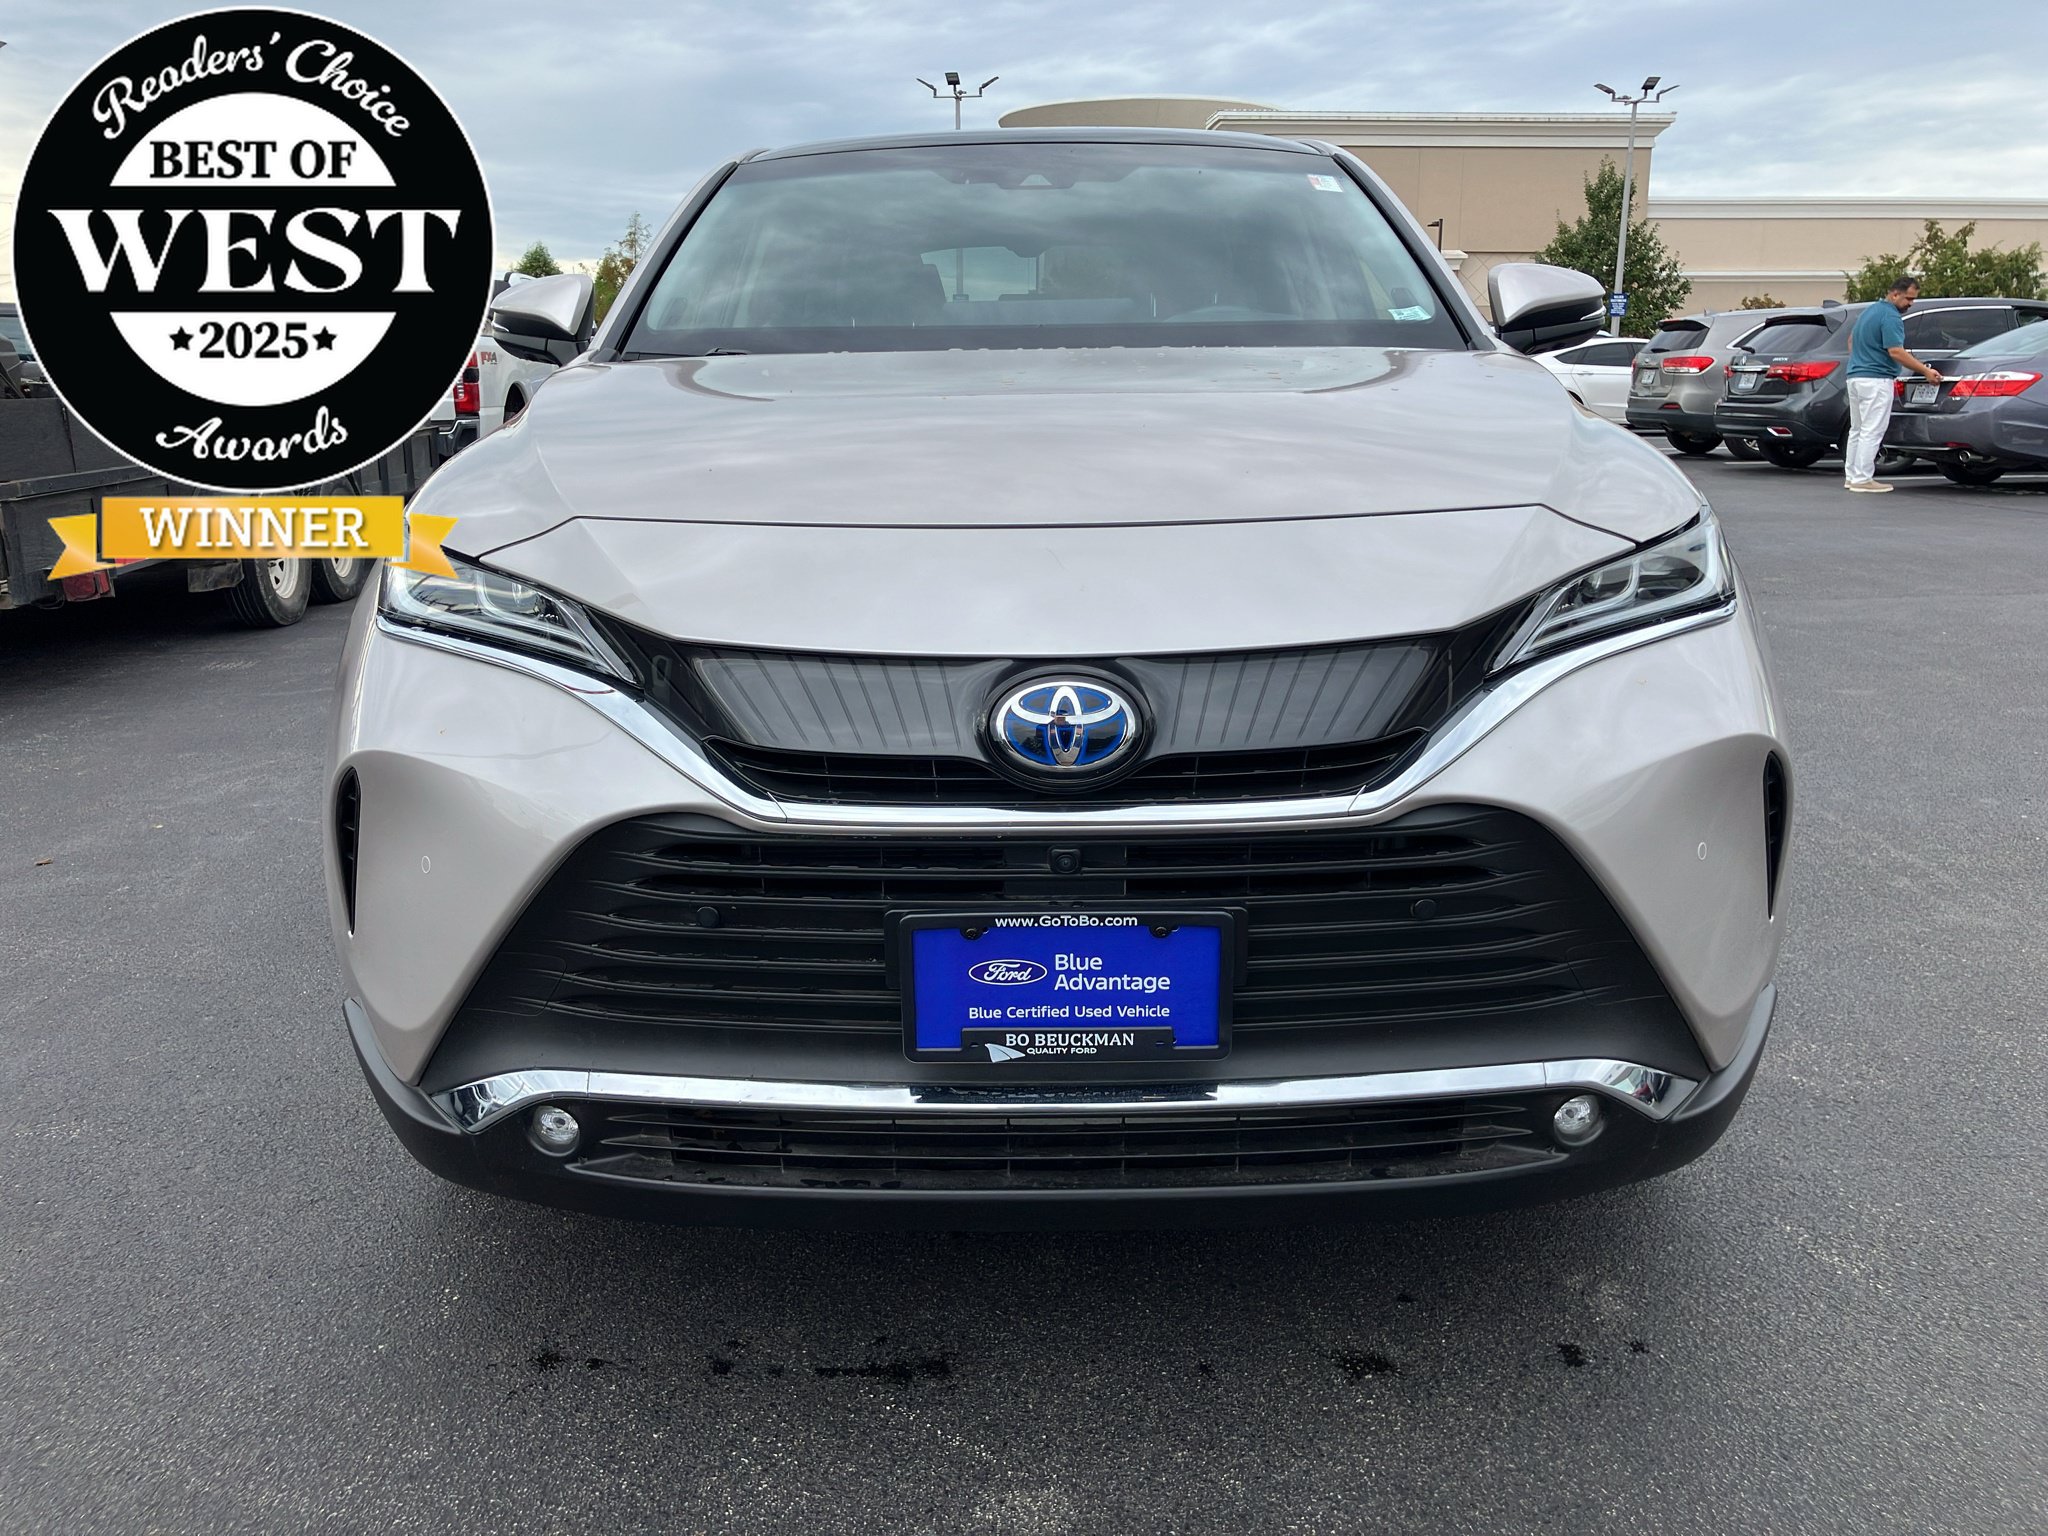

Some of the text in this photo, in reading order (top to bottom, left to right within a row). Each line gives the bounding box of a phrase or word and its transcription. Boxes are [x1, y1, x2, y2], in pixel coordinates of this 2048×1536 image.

[995, 915, 1138, 928] www.GoToBo.com
[1054, 953, 1103, 971] Blue
[983, 962, 1032, 982] Ford
[1054, 973, 1171, 993] Advantage
[969, 1004, 1170, 1019] Blue Certified Used Vehicle
[1005, 1032, 1135, 1047] BO BEUCKMAN
[1026, 1046, 1097, 1056] QUALITY FORD
